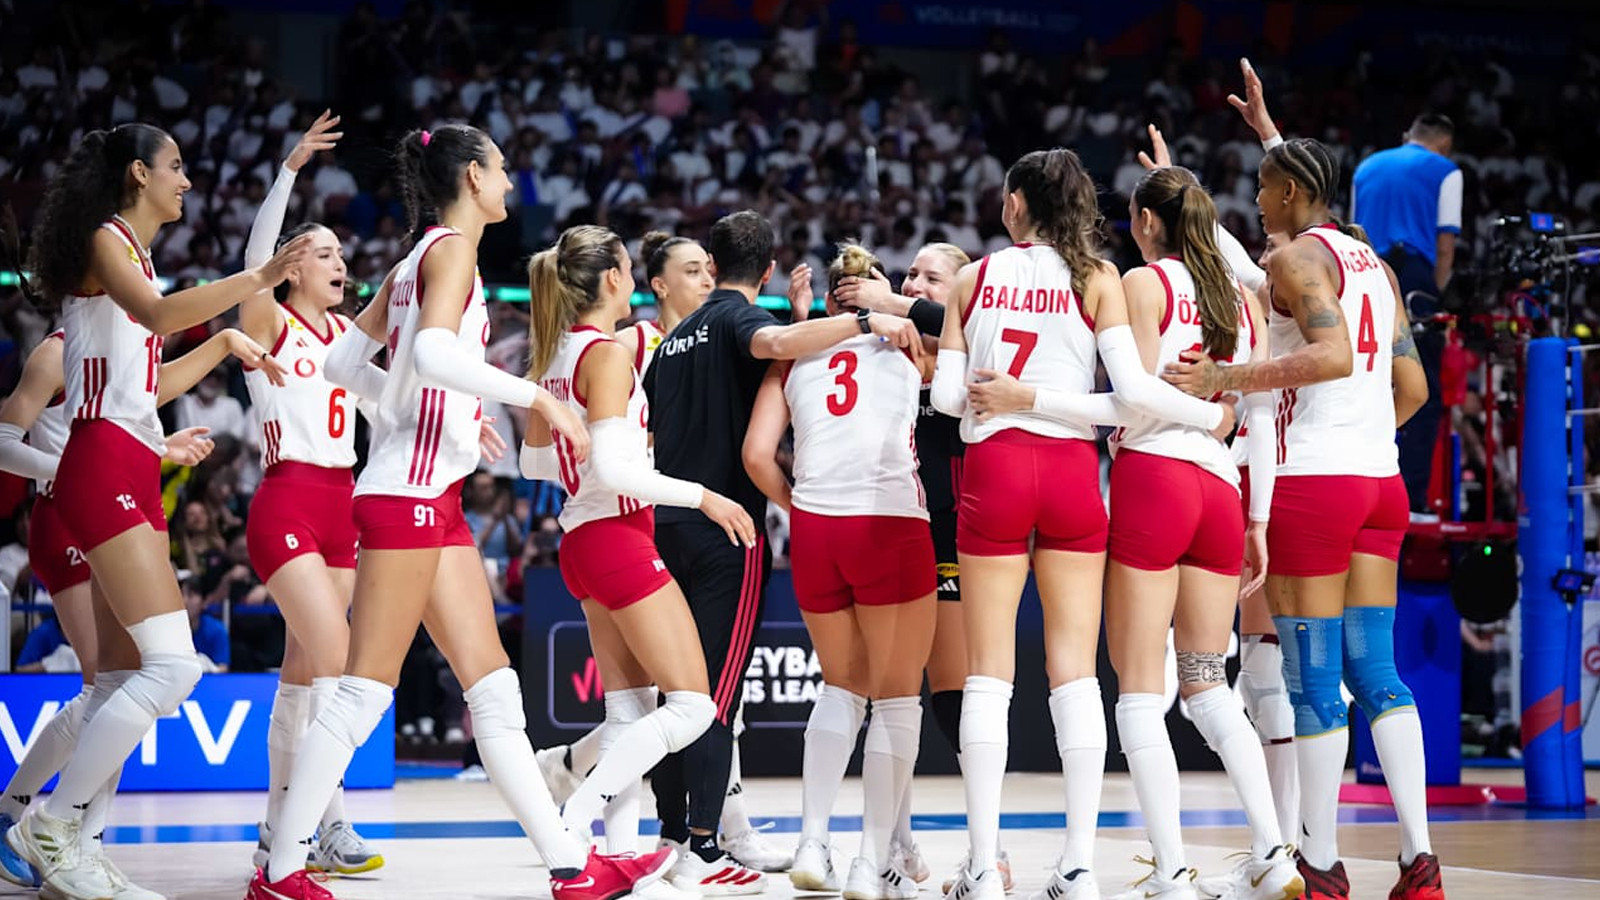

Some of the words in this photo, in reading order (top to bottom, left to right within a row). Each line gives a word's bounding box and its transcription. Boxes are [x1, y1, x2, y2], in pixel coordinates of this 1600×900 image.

[981, 285, 1070, 314] BALADIN
[1001, 328, 1038, 380] 7
[1357, 293, 1378, 372] 4
[827, 350, 858, 417] 3
[328, 387, 346, 439] 6
[285, 533, 299, 550] 6
[414, 504, 435, 527] 91
[745, 646, 823, 678] EYBA
[0, 699, 252, 767] VTV
